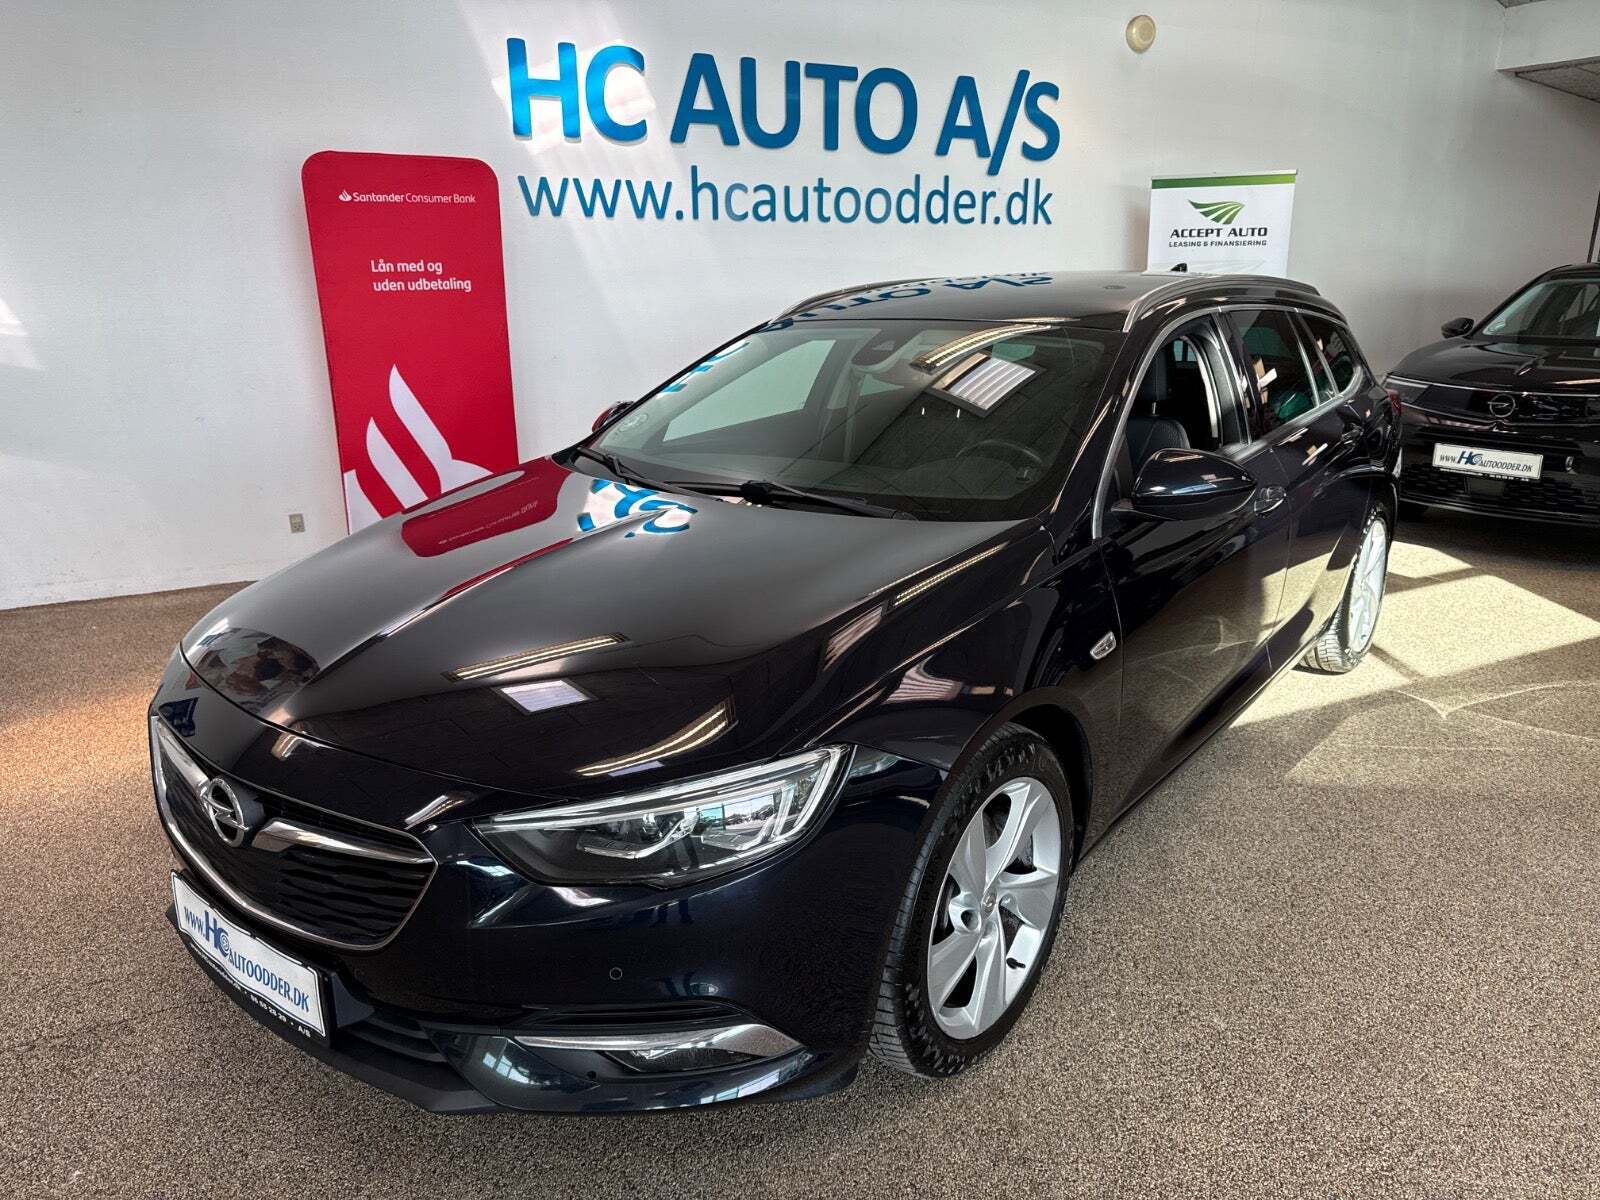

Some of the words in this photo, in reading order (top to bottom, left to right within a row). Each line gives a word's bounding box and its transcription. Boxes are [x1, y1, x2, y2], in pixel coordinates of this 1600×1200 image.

[506, 37, 648, 142] HC
[670, 53, 918, 154] AUTO
[934, 69, 1060, 176] A/S
[352, 191, 405, 203] Santander
[405, 192, 453, 204] Consumer
[453, 193, 477, 204] Bank
[517, 165, 1053, 225] www.hcautoodder.dk
[1170, 228, 1223, 238] ACCEPT
[1227, 227, 1268, 238] AUTO
[1210, 239, 1267, 247] FINANSIERING
[370, 258, 395, 273] Lån
[397, 260, 425, 272] med
[427, 261, 443, 275] og
[373, 278, 405, 292] uden
[407, 277, 472, 293] udbetaling
